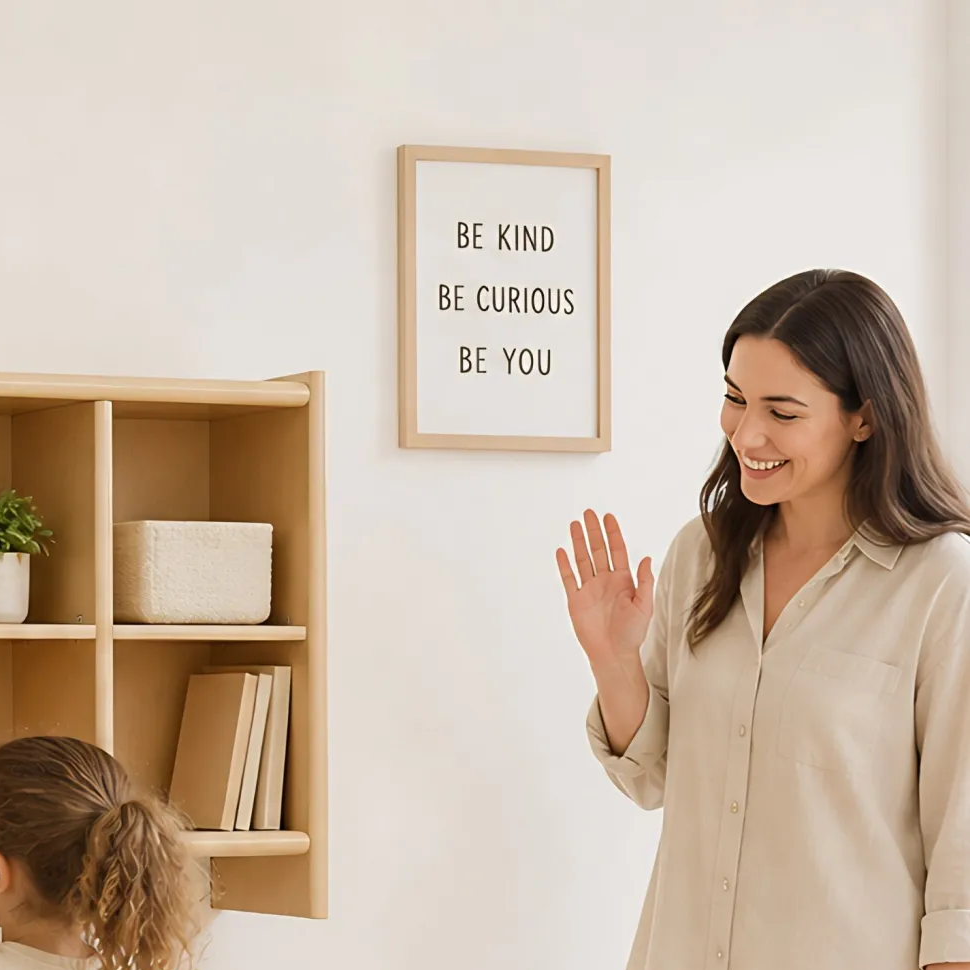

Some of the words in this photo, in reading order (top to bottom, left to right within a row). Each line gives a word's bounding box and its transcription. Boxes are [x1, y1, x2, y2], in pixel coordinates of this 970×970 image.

[457, 221, 484, 250] BE
[498, 223, 555, 253] KIND
[438, 283, 465, 312] BE
[476, 285, 575, 315] CURIOUS
[459, 345, 487, 374] BE
[502, 347, 551, 376] YOU
